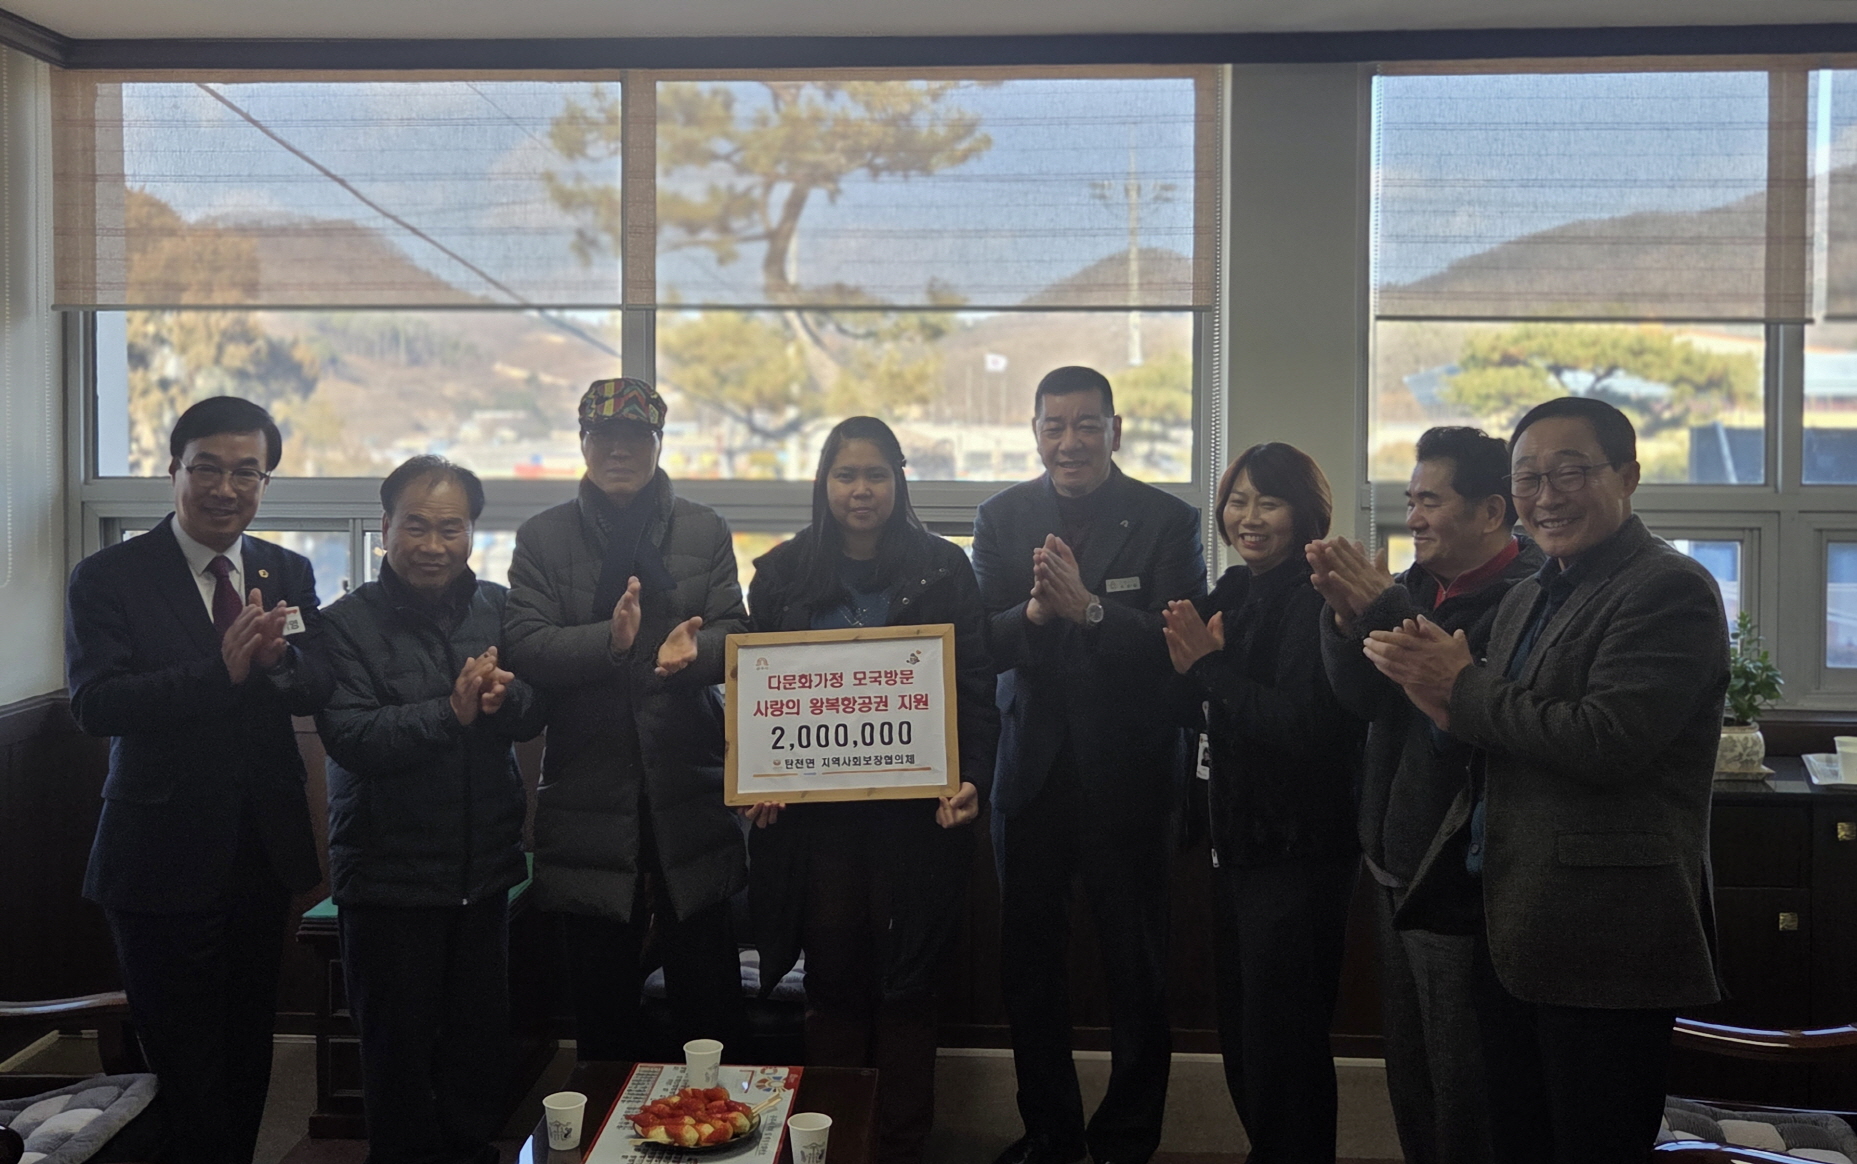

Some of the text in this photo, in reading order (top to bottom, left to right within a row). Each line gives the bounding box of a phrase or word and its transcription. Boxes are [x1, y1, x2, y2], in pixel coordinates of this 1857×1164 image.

[768, 669, 914, 691] 다문화가정 모국방문
[753, 693, 930, 717] 사랑의 왕복항공권 지원
[771, 721, 913, 751] 2,000,000
[784, 754, 915, 769] 탄천면 지역사회보장협의체
